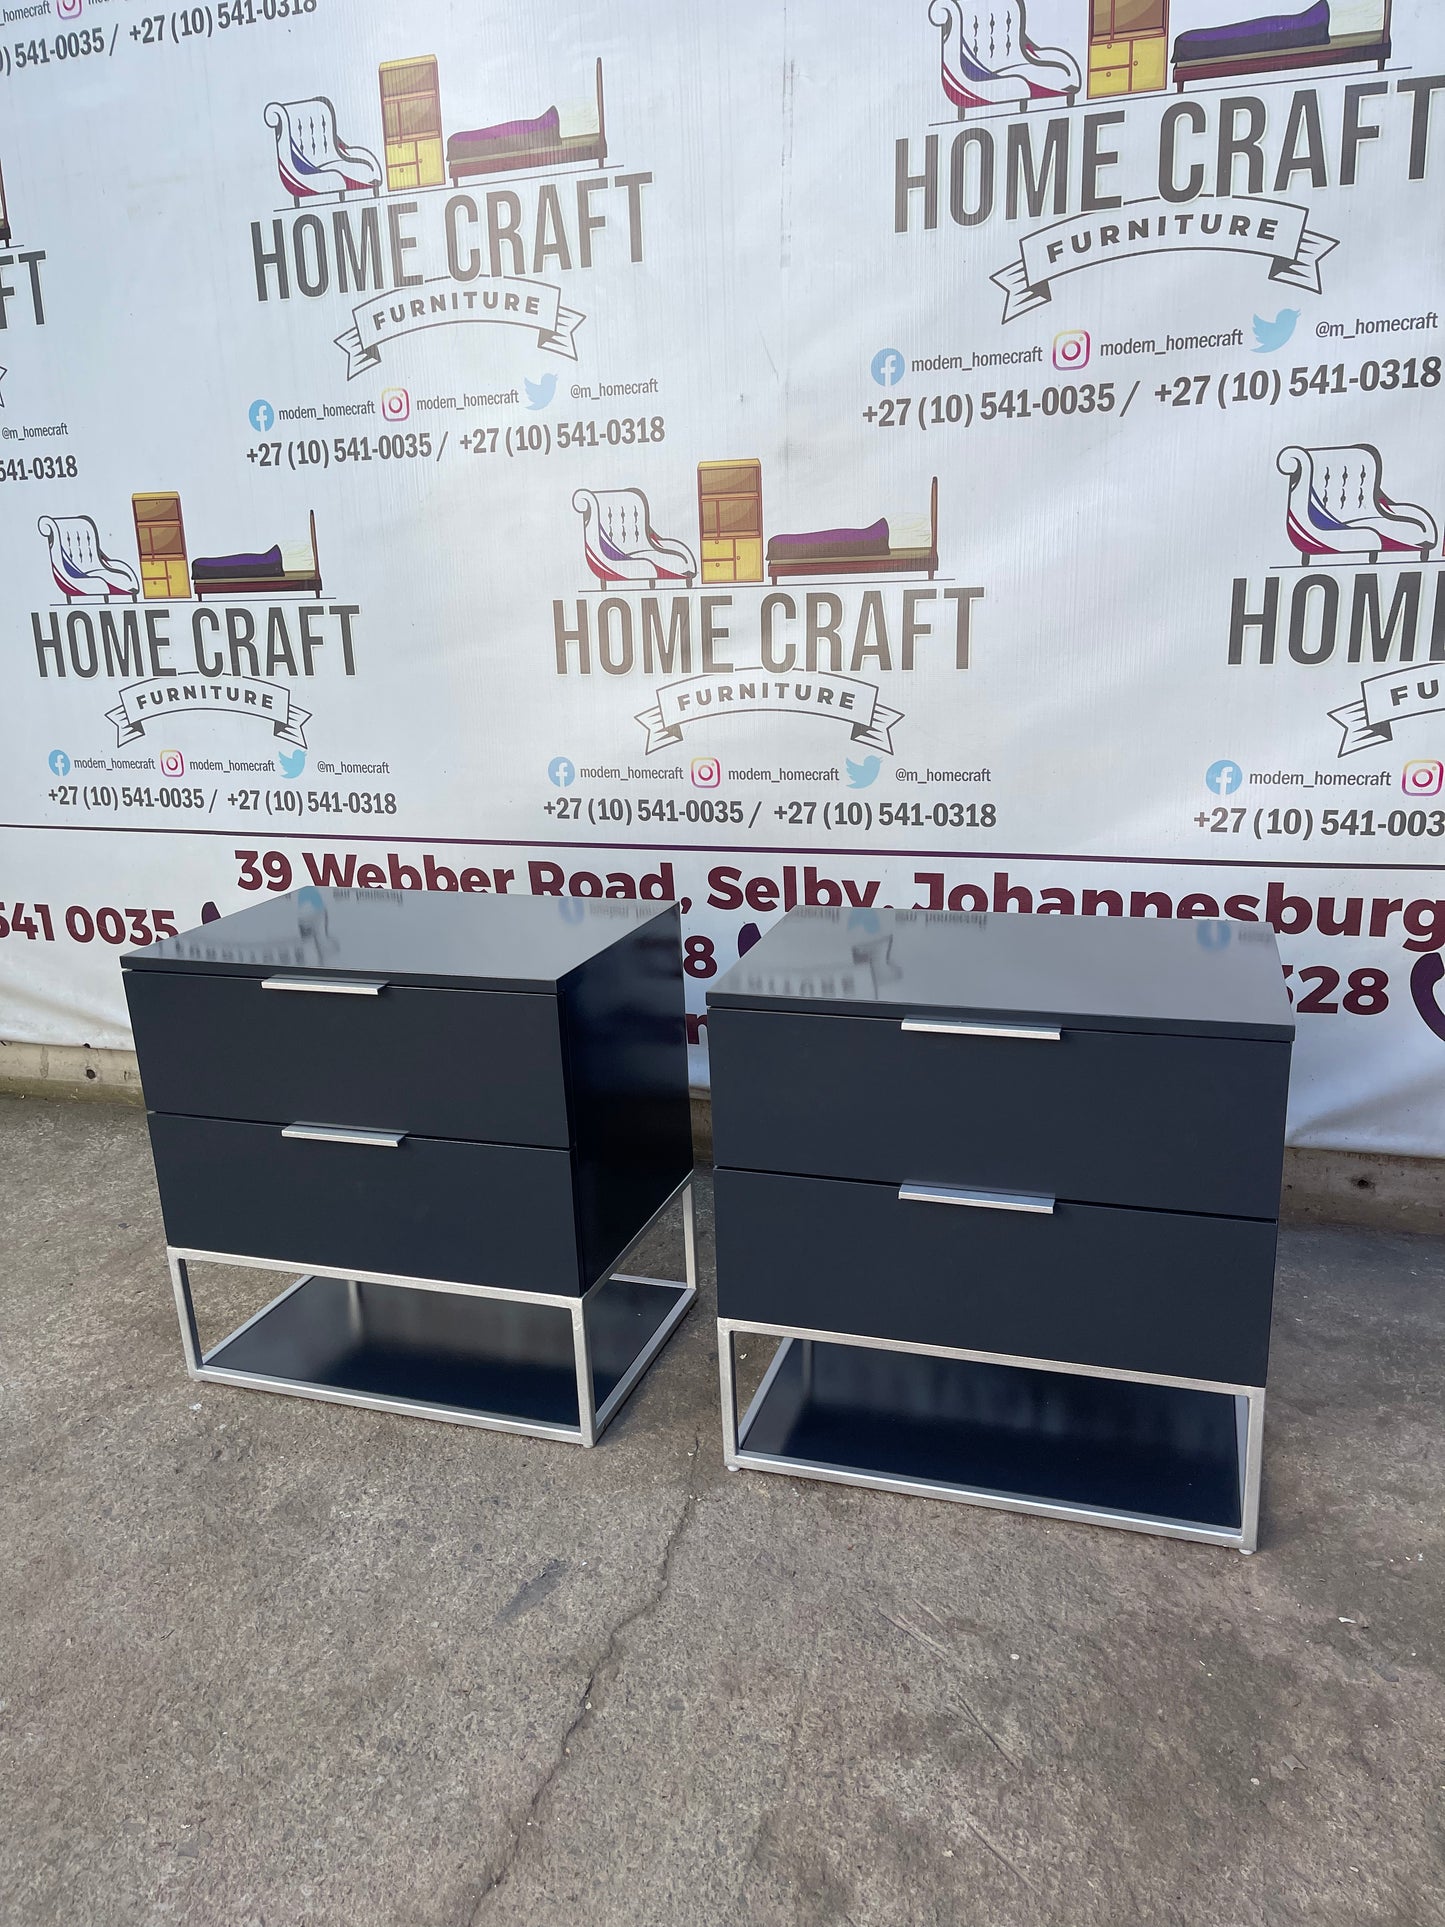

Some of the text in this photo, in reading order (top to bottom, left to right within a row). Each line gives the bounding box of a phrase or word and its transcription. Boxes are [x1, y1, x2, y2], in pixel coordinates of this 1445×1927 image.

[14, 26, 104, 68] 541-0035
[109, 23, 119, 56] /
[129, 12, 166, 44] +27
[171, 5, 213, 44] (10)
[894, 75, 1445, 233] HOME CRAFT
[252, 172, 653, 302] HOME CRAFT
[1046, 212, 1280, 264] FURNITURE
[371, 288, 542, 331] FURNITURE
[912, 312, 1440, 372] modern_homecraft modern_homecraft @m_homecraft
[279, 378, 658, 425] modern_homecraft modern_homecraft @m_homecraft
[863, 355, 1443, 430] +27 (10) 541-0035 / +27 (10) 541-0318
[0, 421, 69, 442] @m_homecraft
[247, 416, 665, 470] +27 (10) 541-0035 / +27 (10) 541-0318
[31, 604, 361, 678] HOME CRAFT
[552, 586, 986, 675] HOME CRAFT
[136, 684, 273, 710] FURNITURE
[677, 682, 858, 713] FURNITURE
[74, 756, 390, 777] modern_homecraft modern_homecraft @m_homecraft
[580, 763, 991, 786] modern_homecraft modern_homecraft @m_homecraft
[1249, 768, 1392, 791] modern_homecraft
[48, 785, 397, 816] +27 (10) 541-0035 / +27 (10) 541-0318
[544, 796, 996, 832] +27 (10) 541-0035 / +27 (10) 541-0318
[1194, 807, 1247, 833] +27
[1254, 806, 1313, 841] (10)
[233, 849, 1445, 953] 39 Webber Road, Selby Johannesburg
[65, 904, 181, 947] 0035
